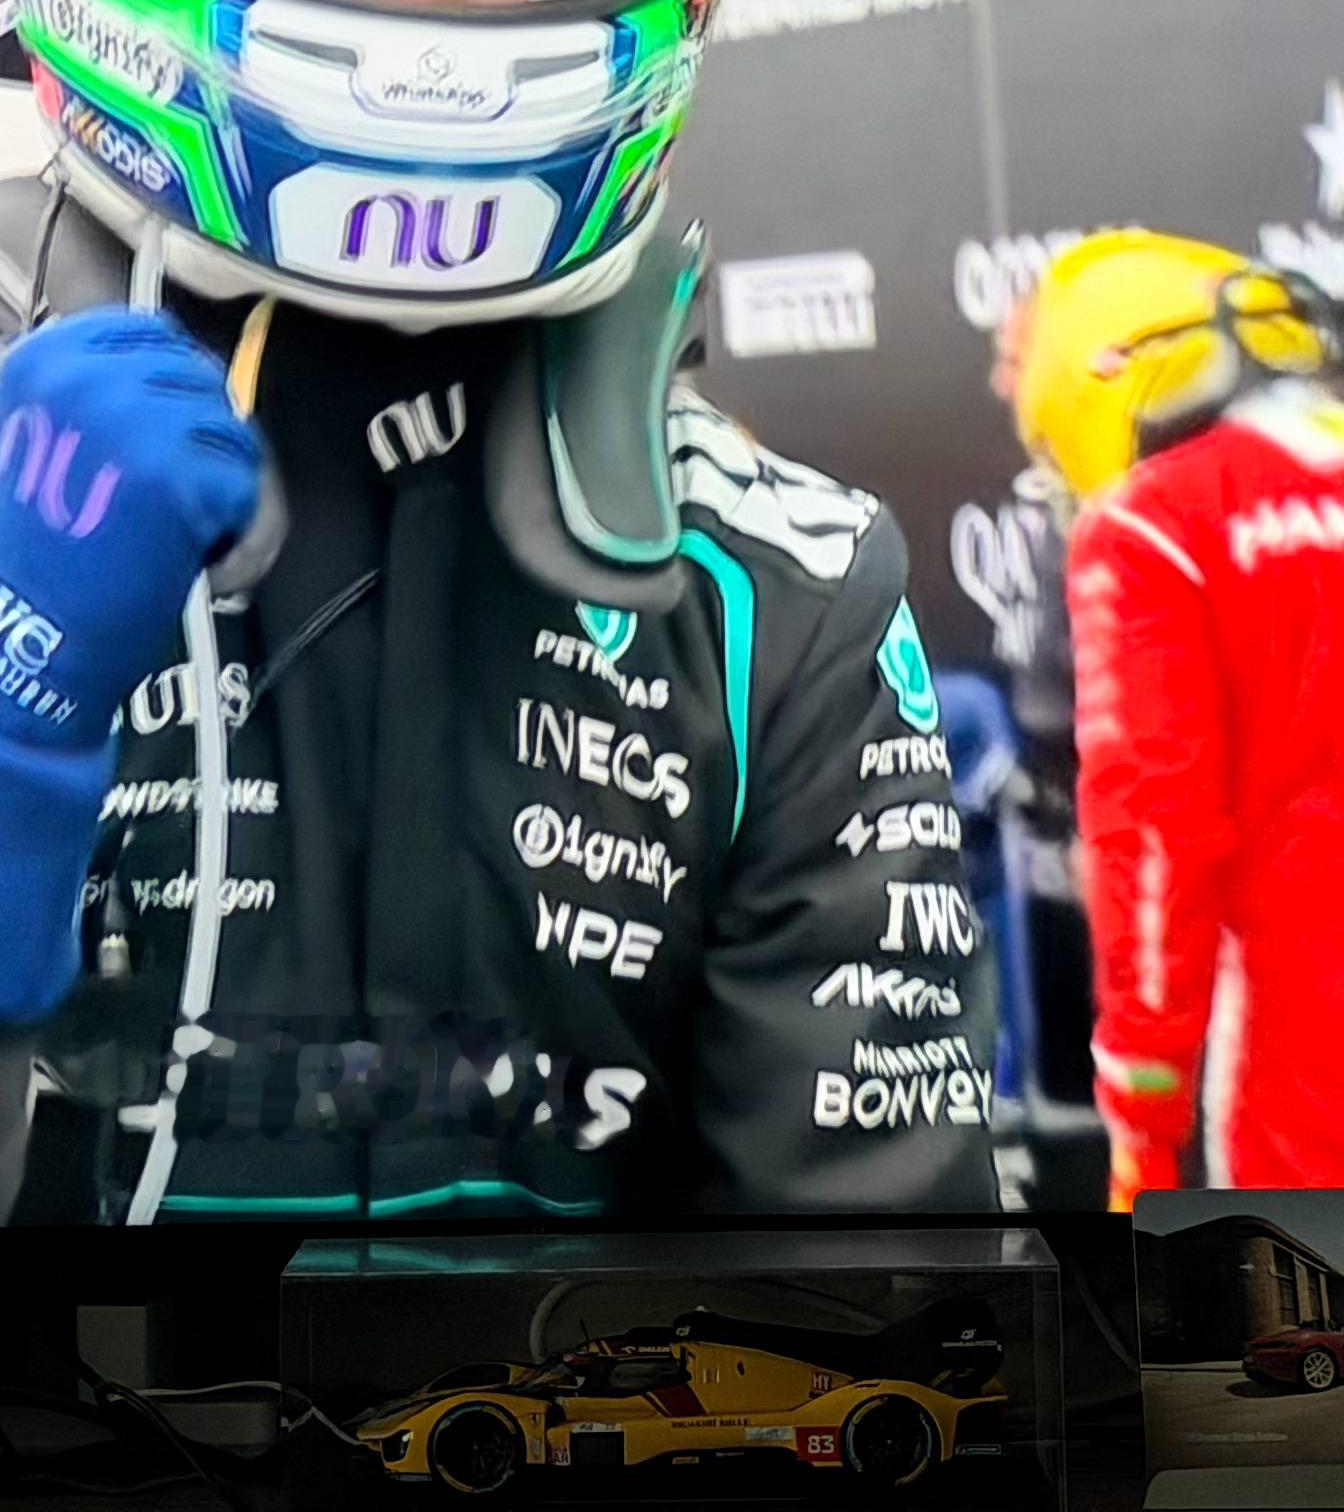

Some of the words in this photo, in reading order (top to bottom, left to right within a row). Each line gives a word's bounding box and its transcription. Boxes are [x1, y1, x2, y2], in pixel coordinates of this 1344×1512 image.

[878, 880, 975, 957] IWC
[812, 1067, 993, 1130] BONVOY
[807, 1435, 836, 1455] 83
